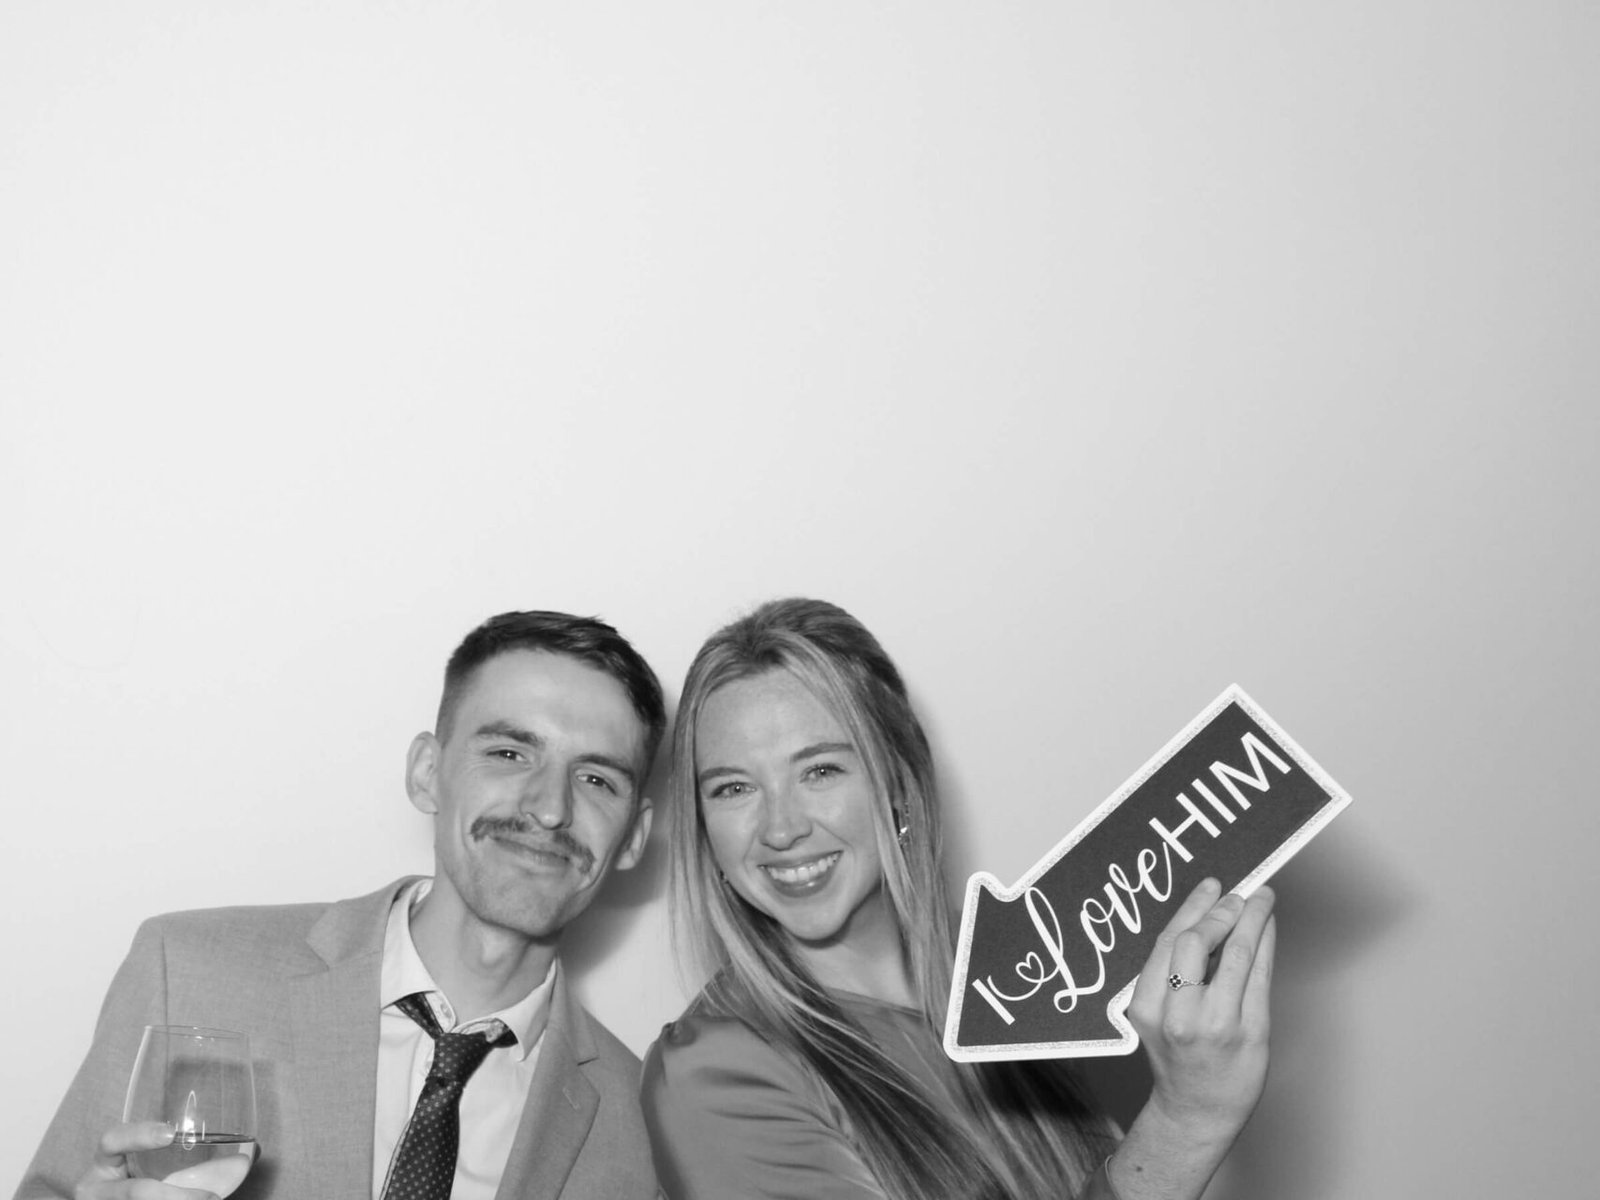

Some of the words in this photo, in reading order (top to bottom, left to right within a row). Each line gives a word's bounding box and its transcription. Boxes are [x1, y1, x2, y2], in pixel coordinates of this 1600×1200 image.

[1148, 731, 1291, 863] HIM
[987, 842, 1172, 1013] Love
[972, 978, 1015, 1025] I
